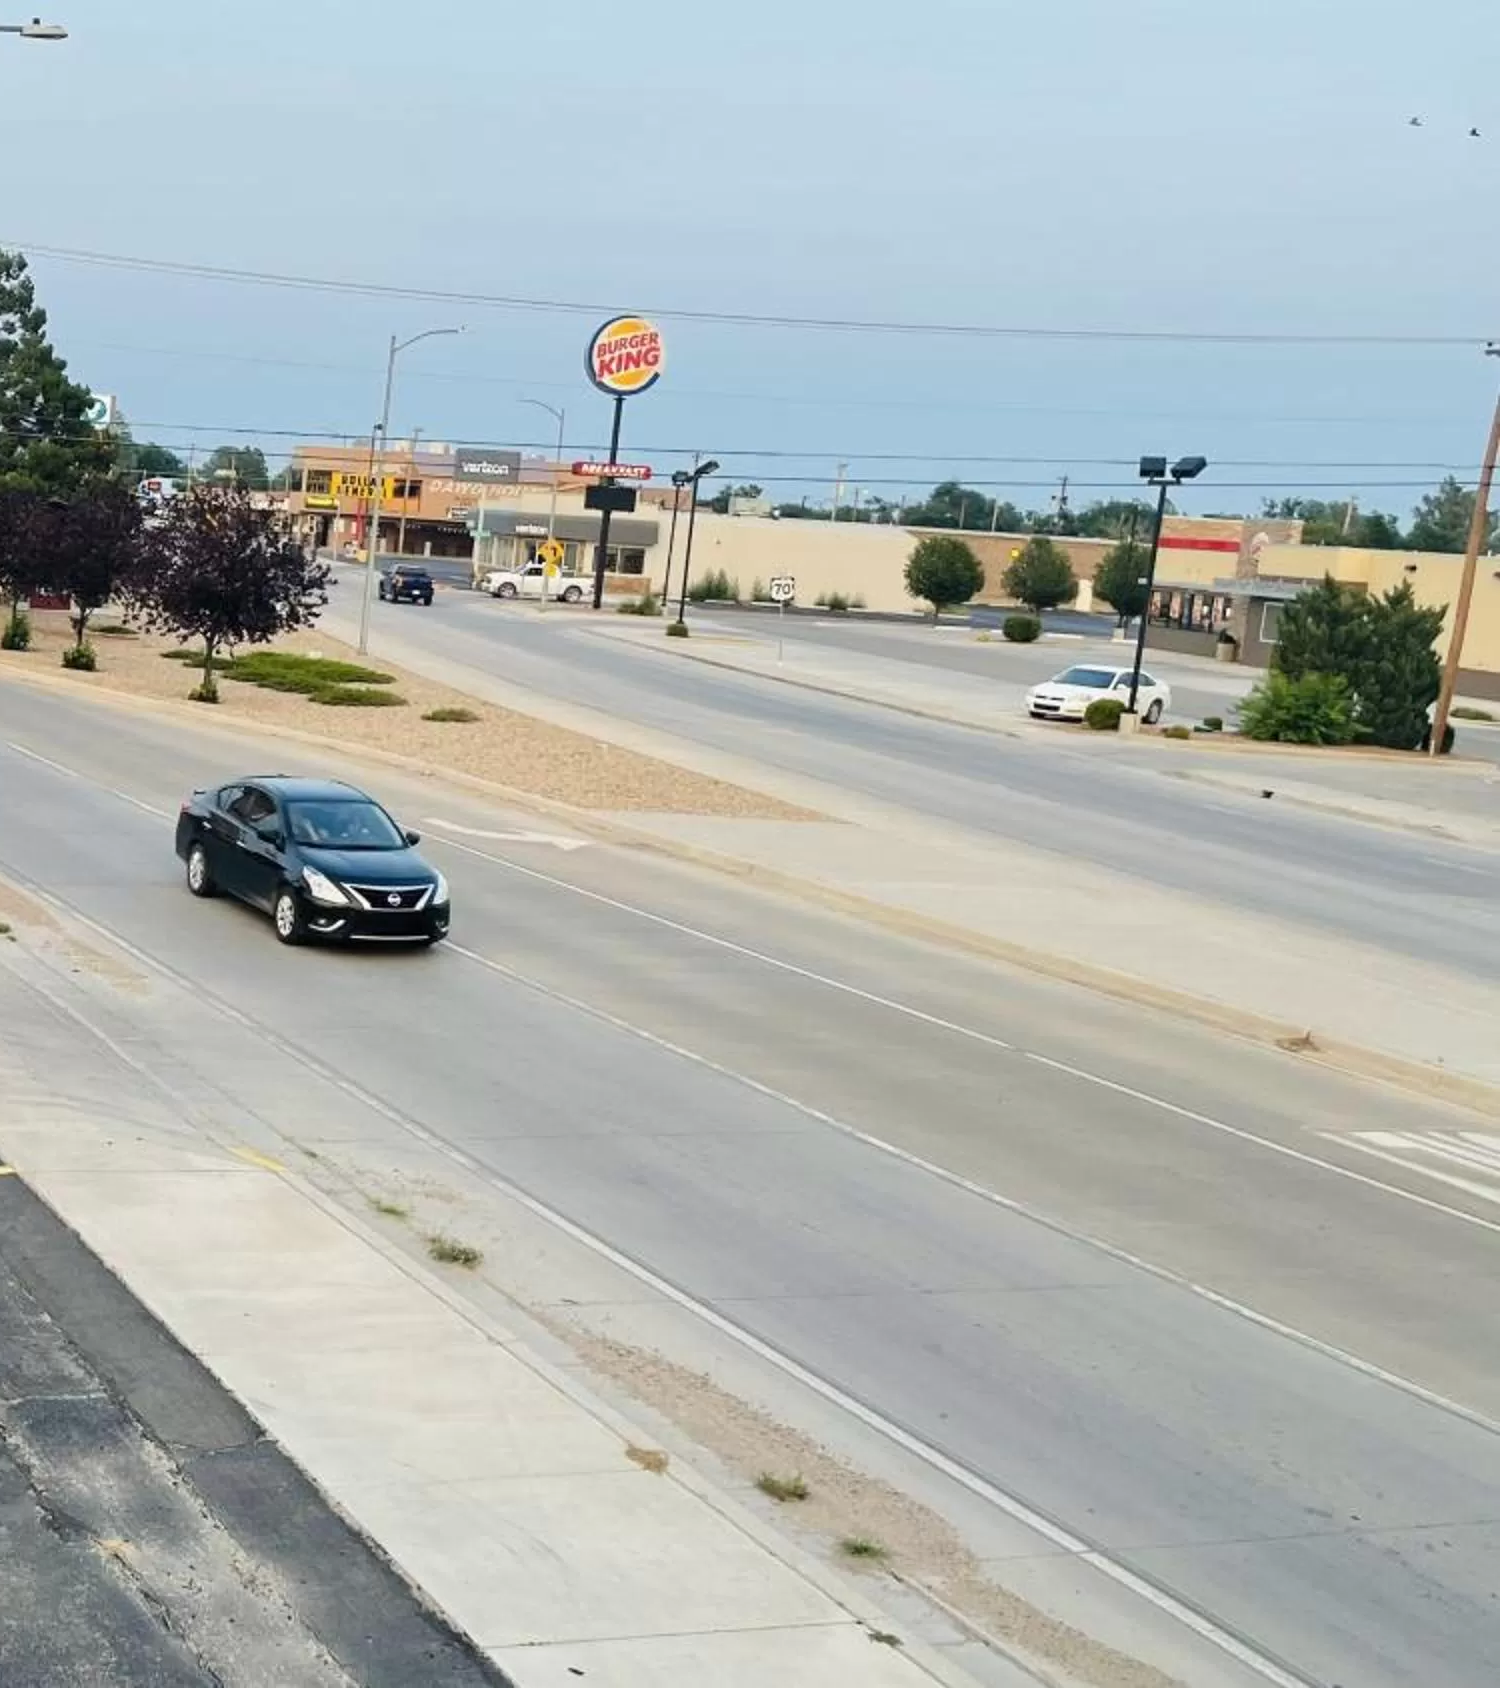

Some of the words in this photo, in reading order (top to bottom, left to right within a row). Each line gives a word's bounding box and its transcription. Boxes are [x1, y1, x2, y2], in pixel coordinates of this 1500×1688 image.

[596, 332, 660, 359] BURGER
[598, 348, 660, 377] KING
[461, 460, 509, 475] verizon
[774, 583, 791, 595] 70
